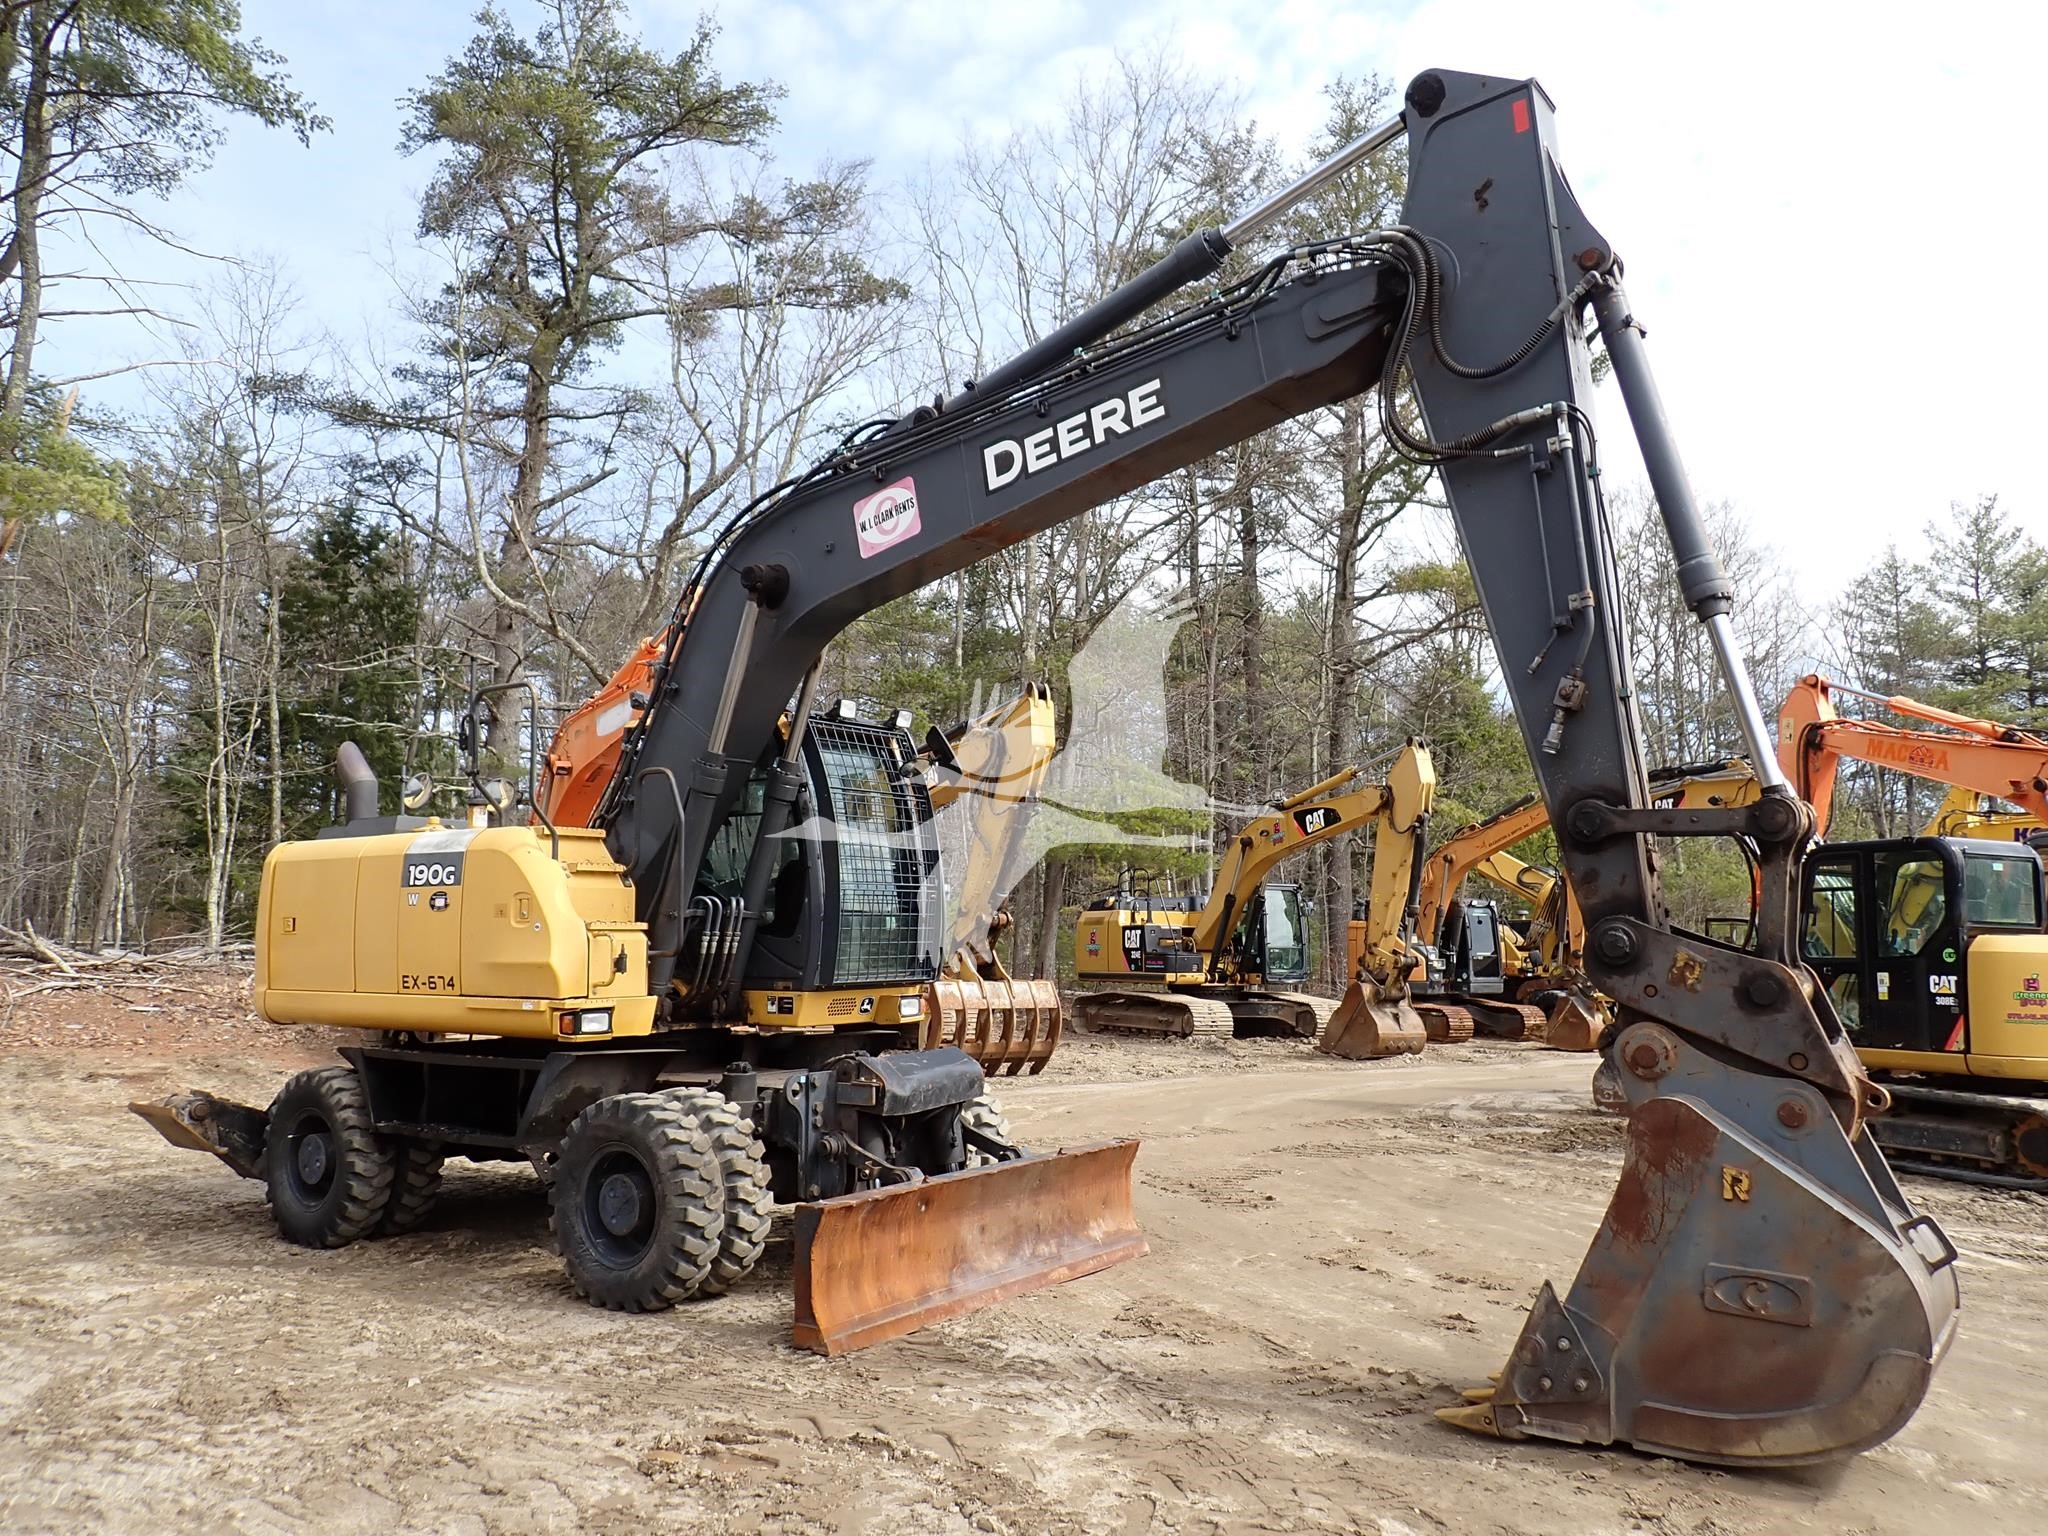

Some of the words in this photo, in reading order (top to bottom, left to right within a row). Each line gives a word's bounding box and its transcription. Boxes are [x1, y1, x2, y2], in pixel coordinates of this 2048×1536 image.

[983, 378, 1166, 491] DEERE
[859, 519, 868, 533] W.
[873, 507, 894, 527] CLARK
[894, 497, 915, 516] RENTS
[1655, 798, 1673, 809] CAT
[1305, 808, 1325, 833] CAT
[408, 863, 456, 886] 190G
[407, 893, 419, 906] W
[1124, 929, 1141, 948] CAT
[401, 974, 456, 991] EX-674
[1929, 975, 1958, 994] CAT
